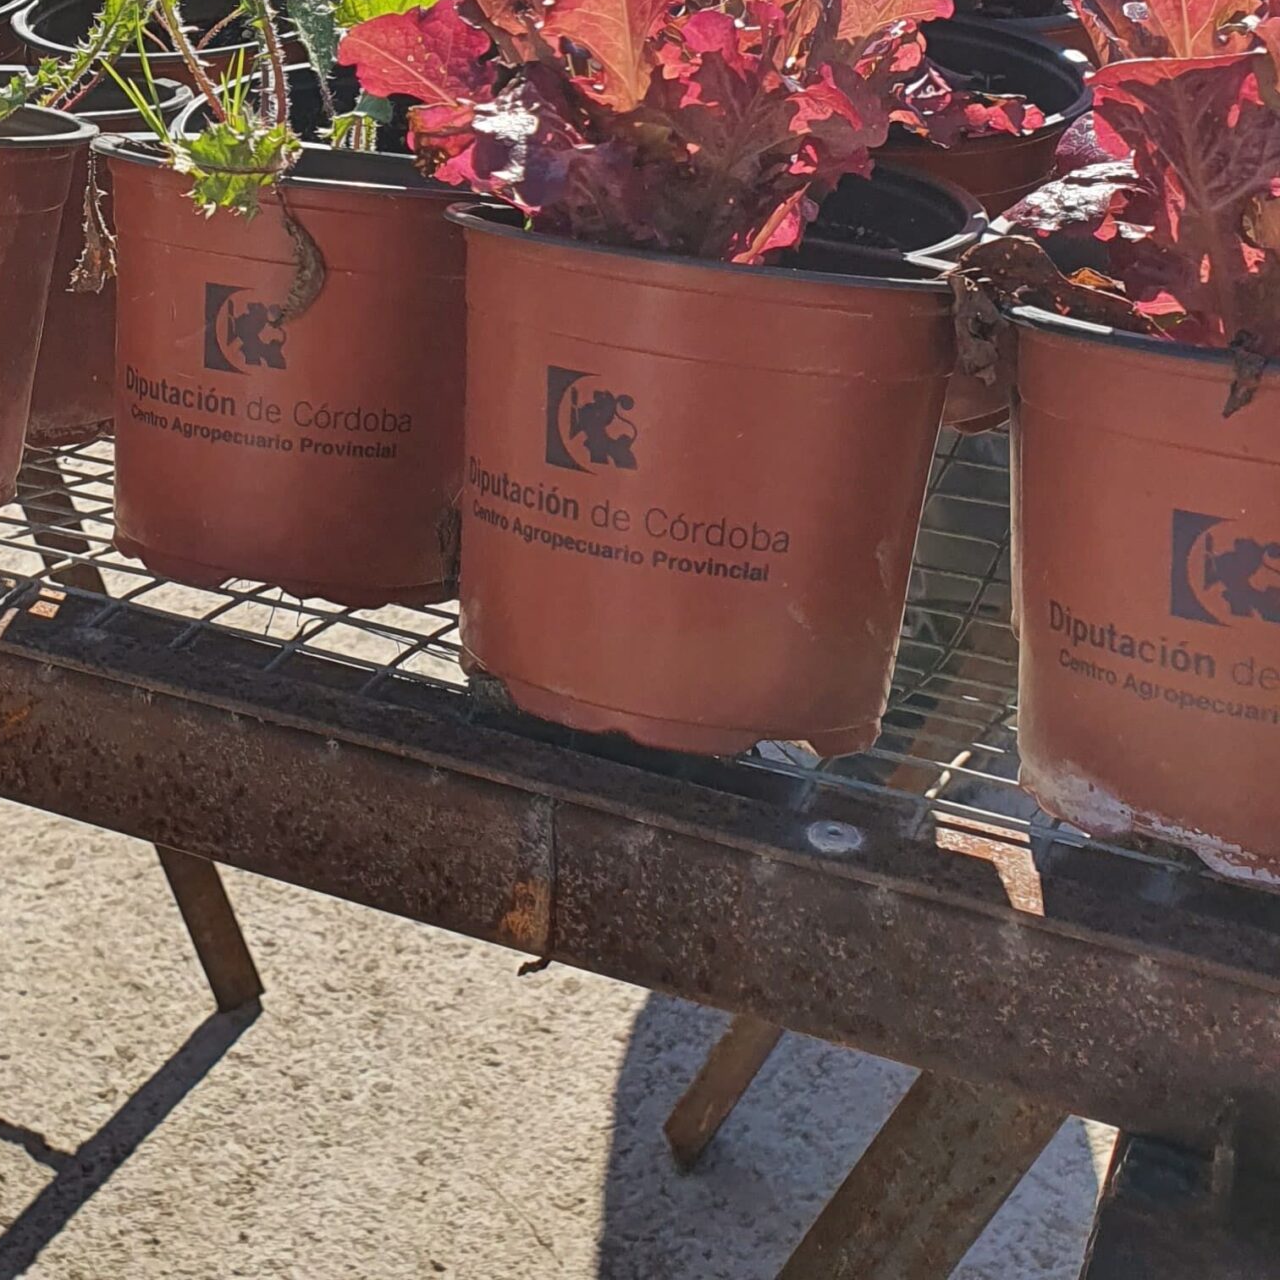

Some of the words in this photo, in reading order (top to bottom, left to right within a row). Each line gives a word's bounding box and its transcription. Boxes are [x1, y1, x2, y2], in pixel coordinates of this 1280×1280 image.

[125, 365, 236, 417] Diputación
[246, 395, 281, 424] de
[293, 399, 413, 434] Córdoba
[130, 404, 169, 430] Centro
[170, 416, 294, 453] Agropecuario
[299, 436, 398, 460] Provincial
[469, 455, 580, 522] Diputación
[591, 499, 631, 533] de
[645, 506, 791, 554] Córdoba
[472, 498, 509, 531] Centro
[512, 516, 645, 566] Agropecuario
[652, 549, 770, 583] Provincial
[1049, 599, 1217, 679] Diputación
[1231, 656, 1280, 691] de
[1059, 648, 1118, 685] Centro
[1122, 672, 1280, 725] Agropecuari
